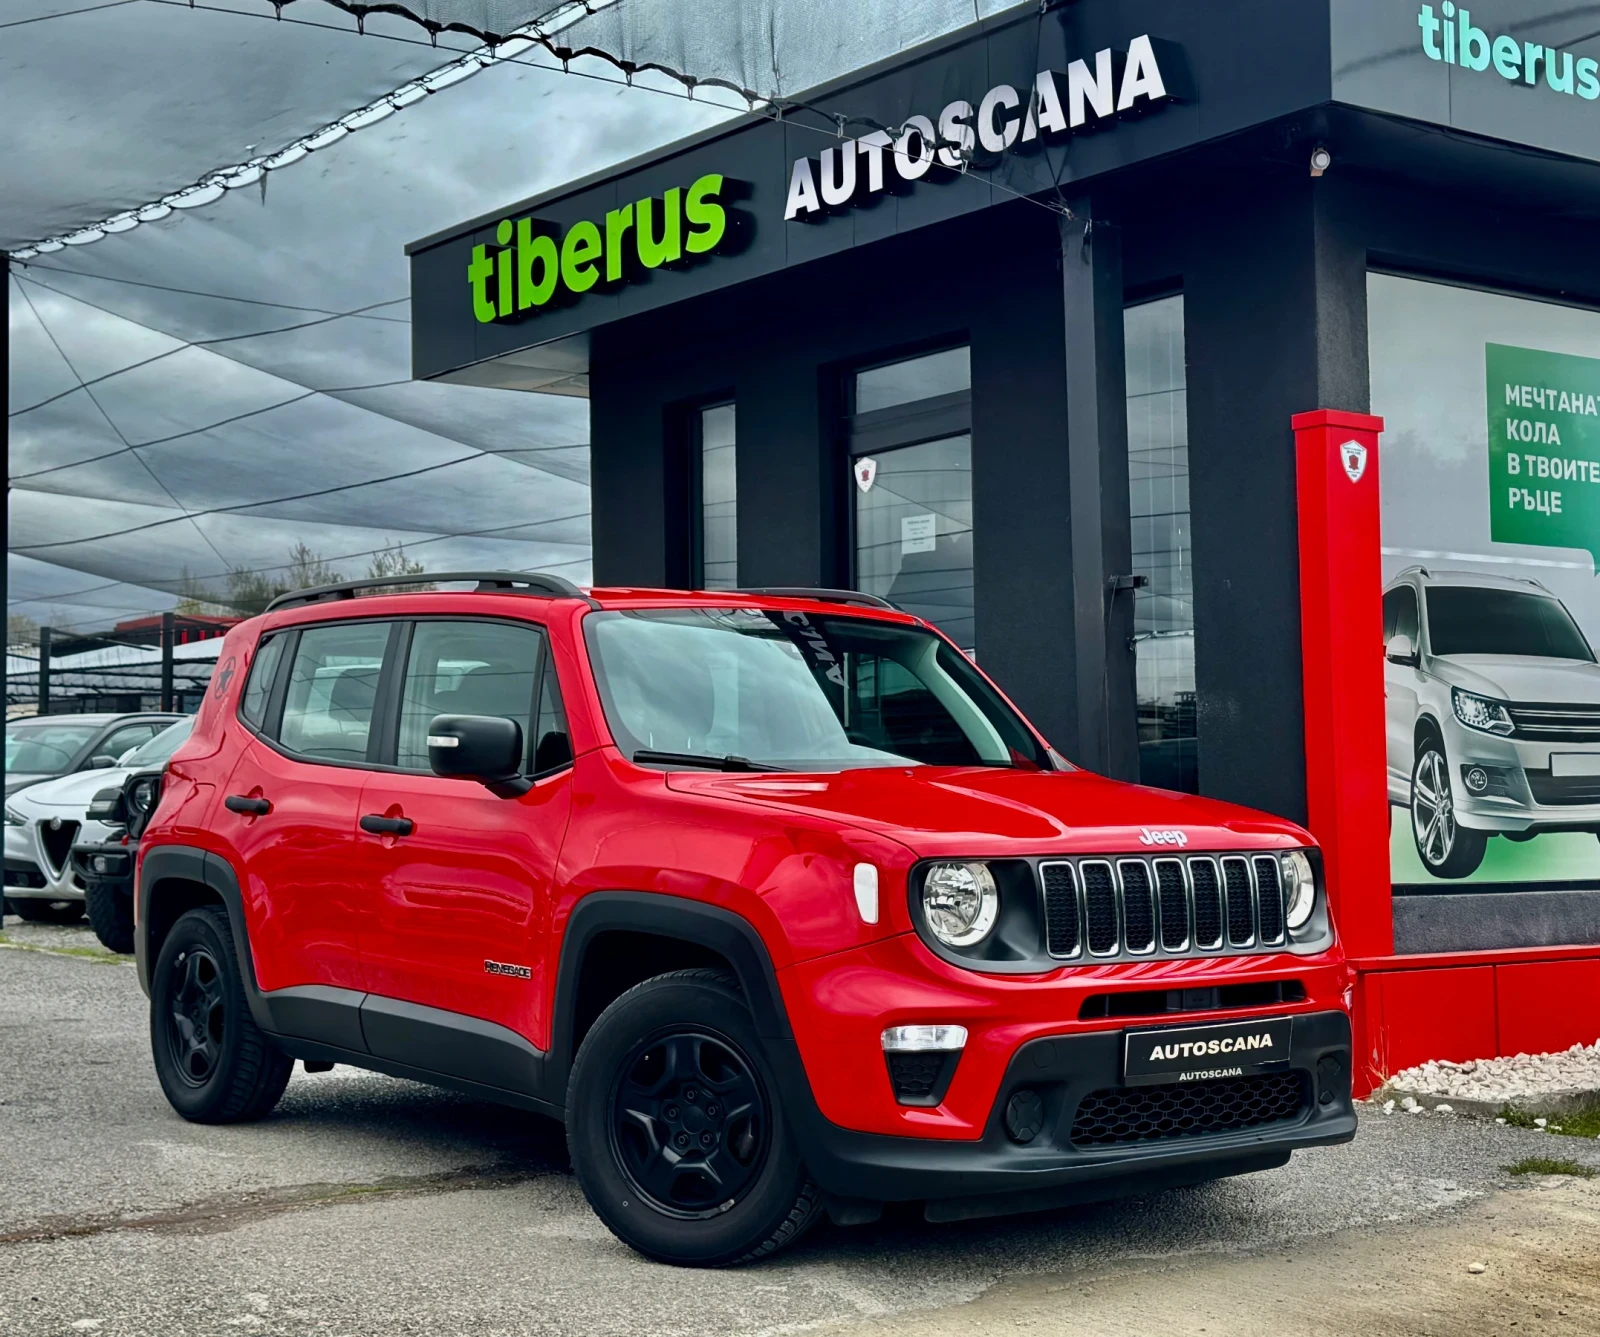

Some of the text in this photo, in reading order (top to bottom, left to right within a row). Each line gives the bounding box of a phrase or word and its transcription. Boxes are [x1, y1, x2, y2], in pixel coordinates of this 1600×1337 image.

[1418, 0, 1600, 100] tiberus
[467, 34, 1167, 323] tiberus AUTOSCANA
[1506, 417, 1561, 446] КОЛА
[1507, 452, 1600, 484] В ТВОИТЕ
[1508, 487, 1563, 517] РЪЦЕ
[1138, 827, 1188, 848] Jeep
[484, 959, 532, 980] RENEGADE
[1149, 1033, 1273, 1061] AUTOSCANA
[1178, 1067, 1243, 1081] AUTOSCANA
